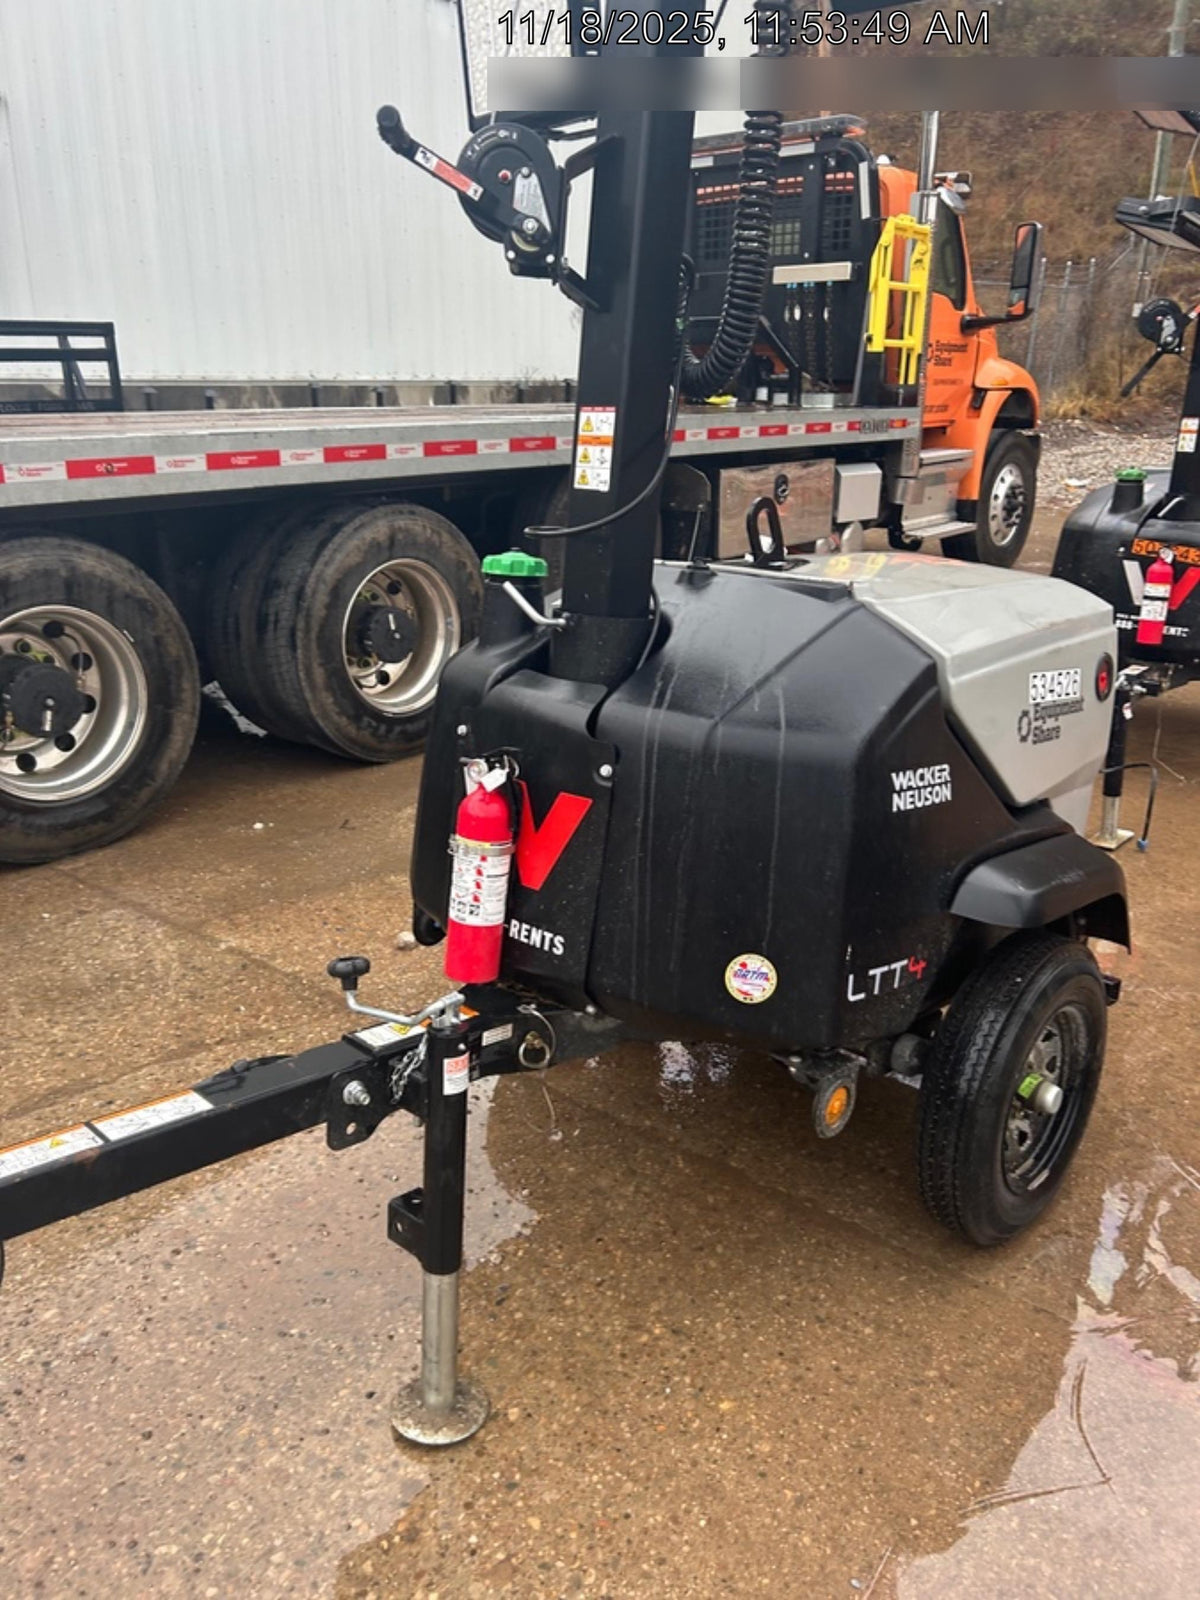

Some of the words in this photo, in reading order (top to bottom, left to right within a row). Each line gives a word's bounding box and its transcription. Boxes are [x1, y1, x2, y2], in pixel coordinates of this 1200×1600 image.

[1031, 669, 1080, 702] 534526
[1032, 724, 1061, 744] Share
[890, 763, 951, 791] WACKER
[892, 782, 953, 813] NEUSON
[847, 955, 928, 1002] LTT4
